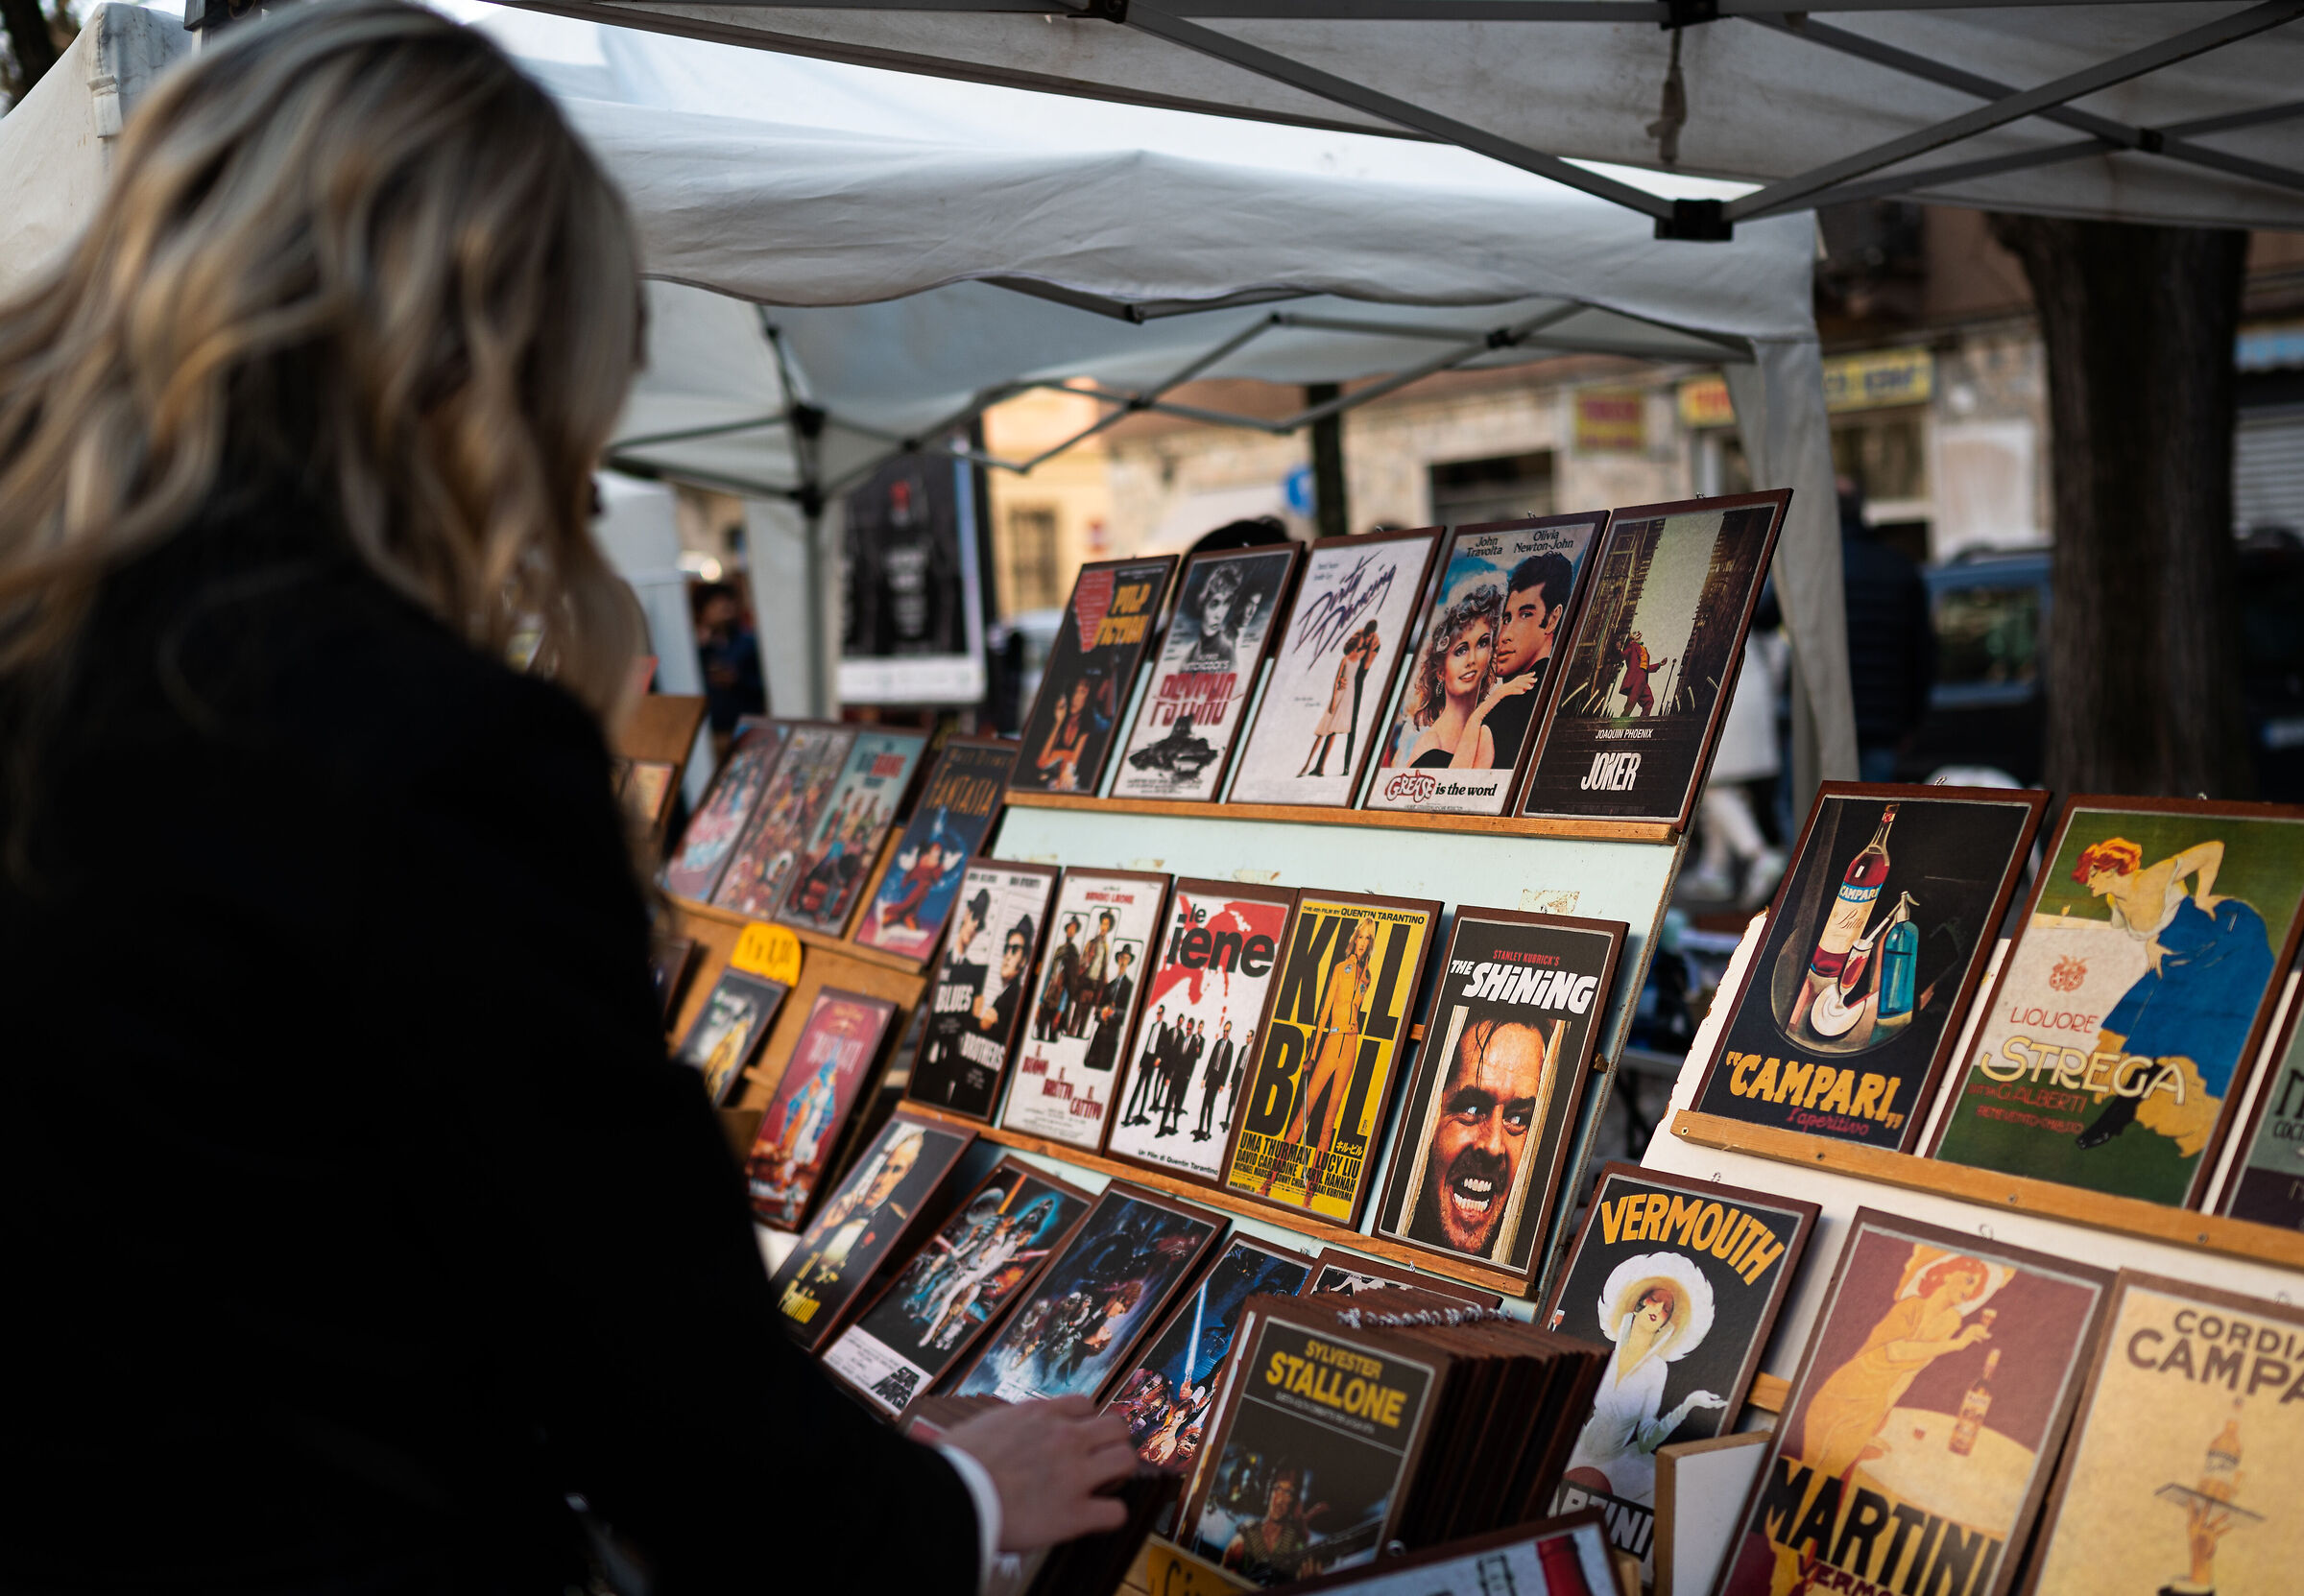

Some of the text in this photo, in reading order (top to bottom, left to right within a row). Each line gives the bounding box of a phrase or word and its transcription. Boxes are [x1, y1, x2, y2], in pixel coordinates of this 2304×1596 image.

[1476, 536, 1499, 547] John
[1514, 540, 1574, 554] Newton-John
[1533, 530, 1560, 541] Olivia
[1466, 546, 1503, 558] Travolta
[1111, 583, 1152, 614] PULP
[1292, 549, 1383, 655] Dirty
[1093, 615, 1150, 645] FICTION
[1306, 563, 1397, 672] Dancing
[1595, 728, 1654, 739] JOAQUIN PHOENIX
[1384, 770, 1498, 803] GREASE is the word
[1580, 752, 1642, 791] JOKER
[1839, 885, 1880, 900] CAMPARI
[1189, 903, 1207, 923] le
[1340, 908, 1377, 919] QUENTIN
[1378, 912, 1425, 925] TARANTINO
[1166, 914, 1276, 978] iene
[1493, 949, 1560, 966] STANLEY KUBRICK'S
[1450, 960, 1476, 975] THE
[934, 984, 974, 1013] BLUES
[960, 1031, 1006, 1072] BROTHERS
[1980, 1036, 2186, 1106] STREGA
[1069, 1097, 1103, 1121] CATTIVO
[1166, 1155, 1188, 1167] Quentin
[1190, 1162, 1219, 1176] Tarantino
[1239, 1131, 1362, 1179] UMA THURMAN LUCY LIU
[1234, 1161, 1254, 1175] MICHAEL
[1275, 1173, 1292, 1185] SONNY
[1236, 1149, 1259, 1165] DAVID
[1258, 1154, 1299, 1178] CARRADINE
[1301, 1166, 1325, 1185] DARYL
[1324, 1172, 1357, 1194] HANNAH
[1600, 1193, 1786, 1286] VERMOUTH
[1305, 1340, 1383, 1380] SYLVESTER
[1265, 1351, 1407, 1428] STALLONE
[1750, 1457, 2004, 1596] MARTINI
